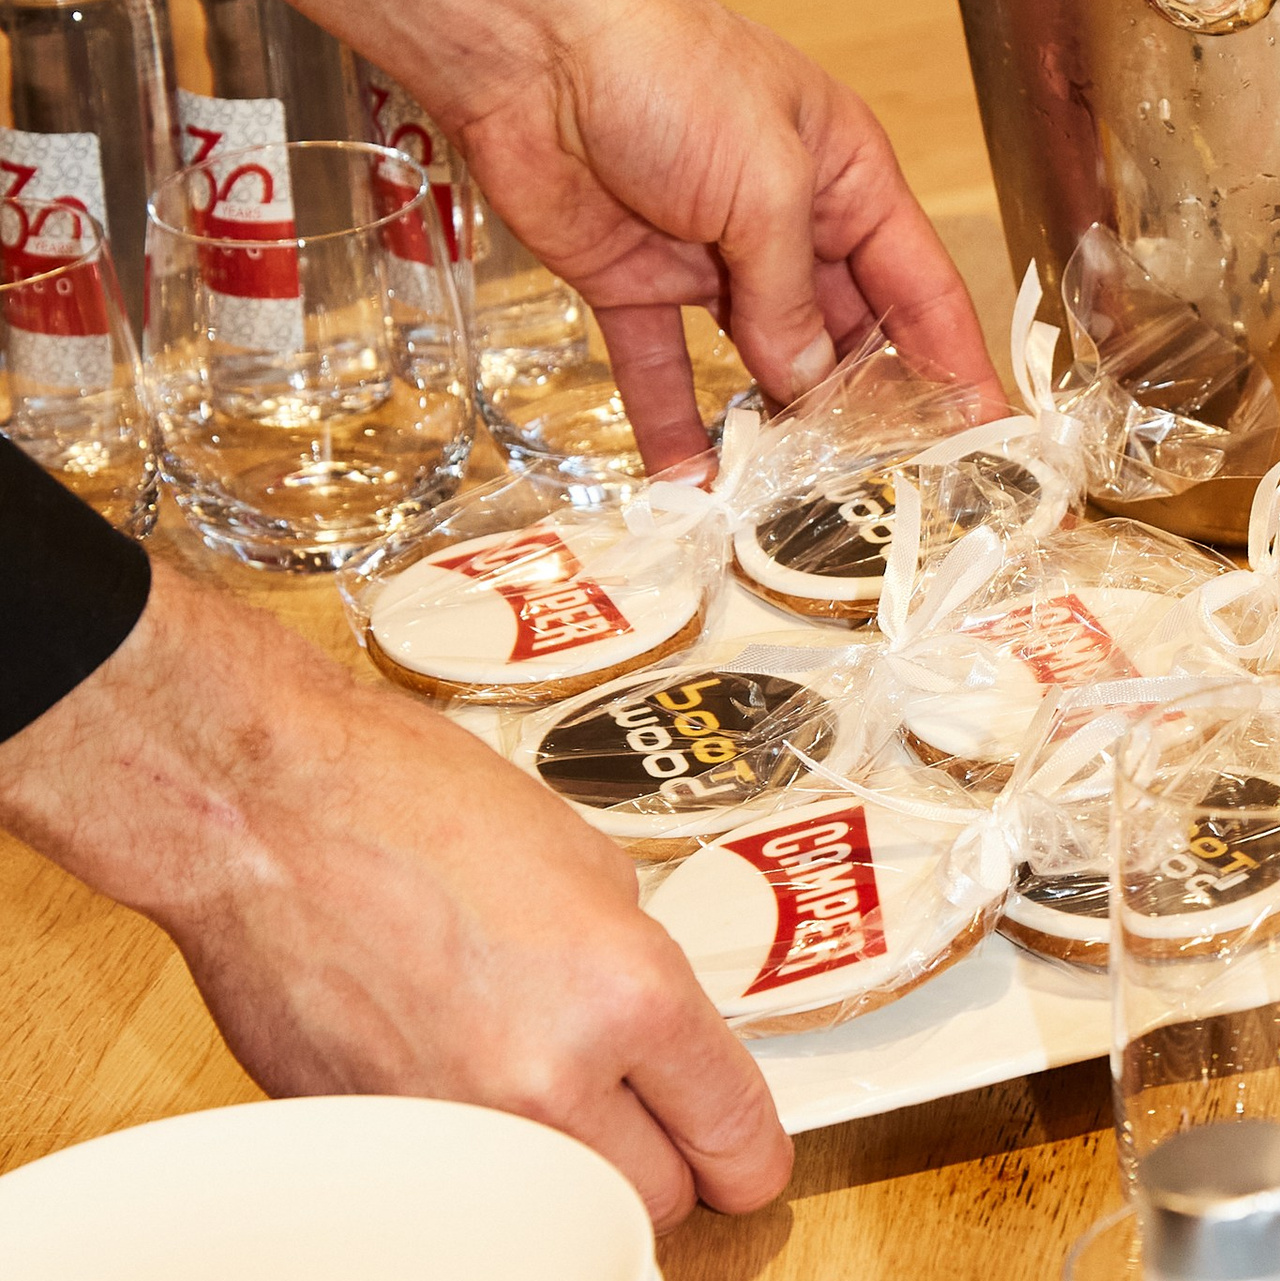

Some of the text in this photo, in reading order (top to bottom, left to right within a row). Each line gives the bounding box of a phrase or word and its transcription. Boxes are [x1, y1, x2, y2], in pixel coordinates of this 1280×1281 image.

[221, 203, 261, 219] YEARS
[470, 542, 612, 651] CMPER
[608, 697, 738, 803] wood
[761, 821, 866, 977] CAMPER
